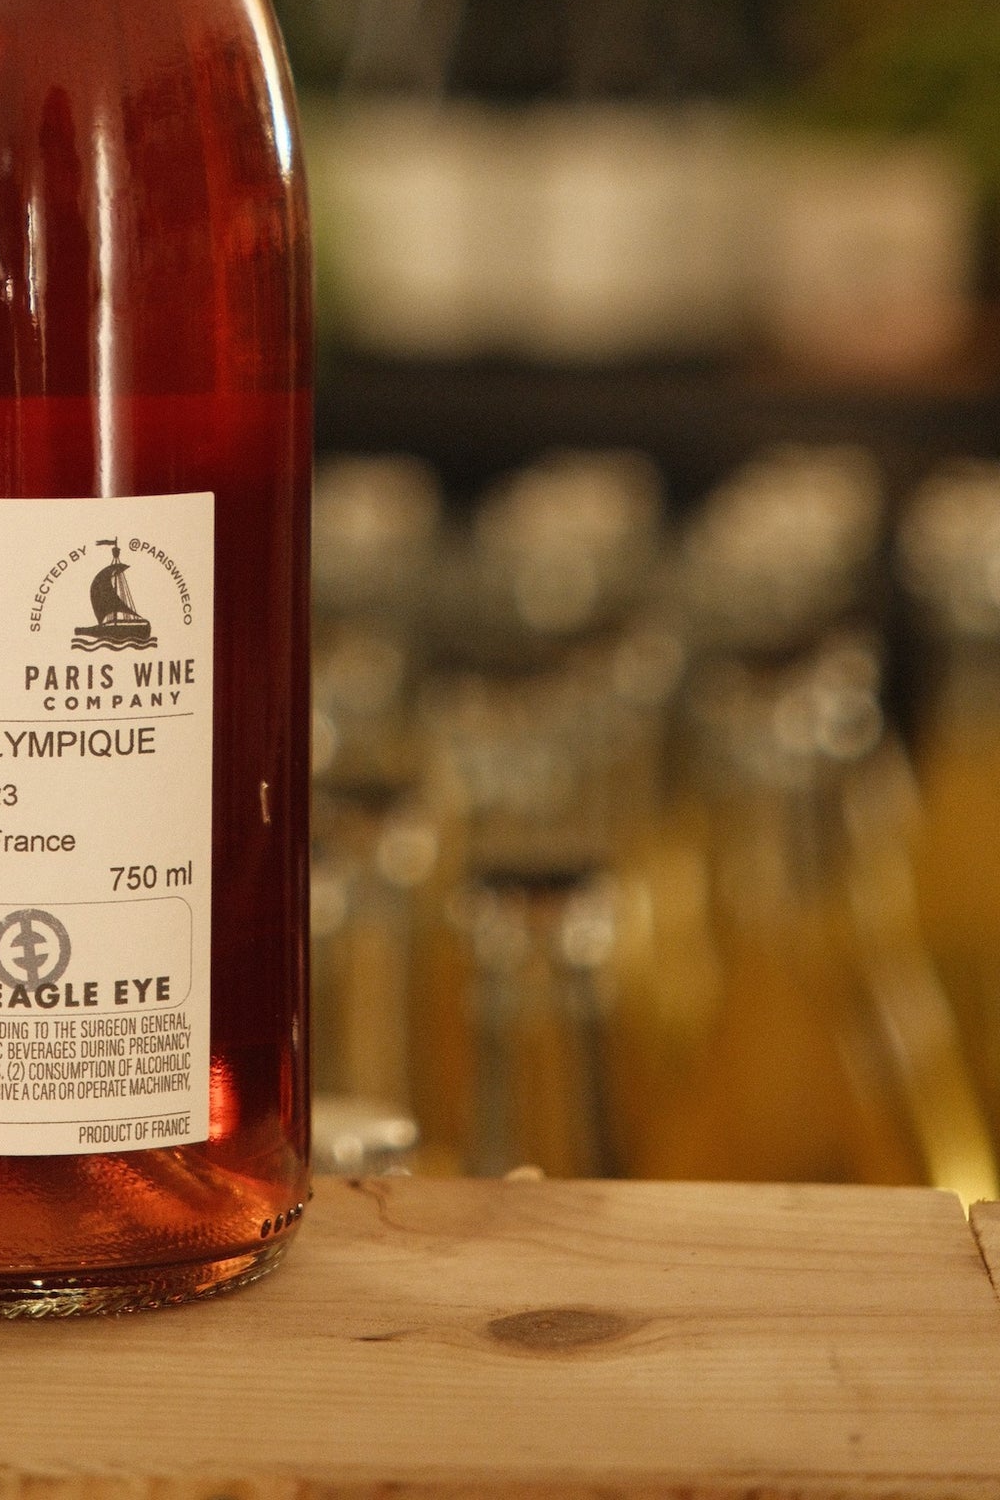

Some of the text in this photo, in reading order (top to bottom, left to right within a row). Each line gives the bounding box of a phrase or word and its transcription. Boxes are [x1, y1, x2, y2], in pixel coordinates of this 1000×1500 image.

[30, 545, 87, 632] SELECTED BY
[129, 538, 192, 625] @PARISWINECO
[25, 659, 195, 690] PARIS WINE
[43, 691, 180, 711] COMPANY
[109, 860, 193, 891] 750 ml
[114, 976, 170, 1005] EYE
[34, 1021, 49, 1039] TO
[54, 1021, 76, 1038] THE
[80, 1017, 136, 1037] SURGEON
[141, 1012, 191, 1033] GENERAL,
[8, 1041, 76, 1060] BEVERAGES
[81, 1038, 125, 1058] DURING
[129, 1032, 191, 1055] PREGNANCY
[7, 1062, 25, 1082] (2)
[29, 1060, 115, 1080] CONSUMPTION
[119, 1059, 132, 1076] OF
[135, 1052, 190, 1075] ALCOHOLIC
[21, 1082, 29, 1100] A
[33, 1083, 56, 1100] CAR
[59, 1082, 74, 1100] OR
[78, 1079, 126, 1099] OPERATE
[129, 1072, 191, 1096] MACHINERY,
[79, 1116, 190, 1144] PRODUCT OF FRANCE
